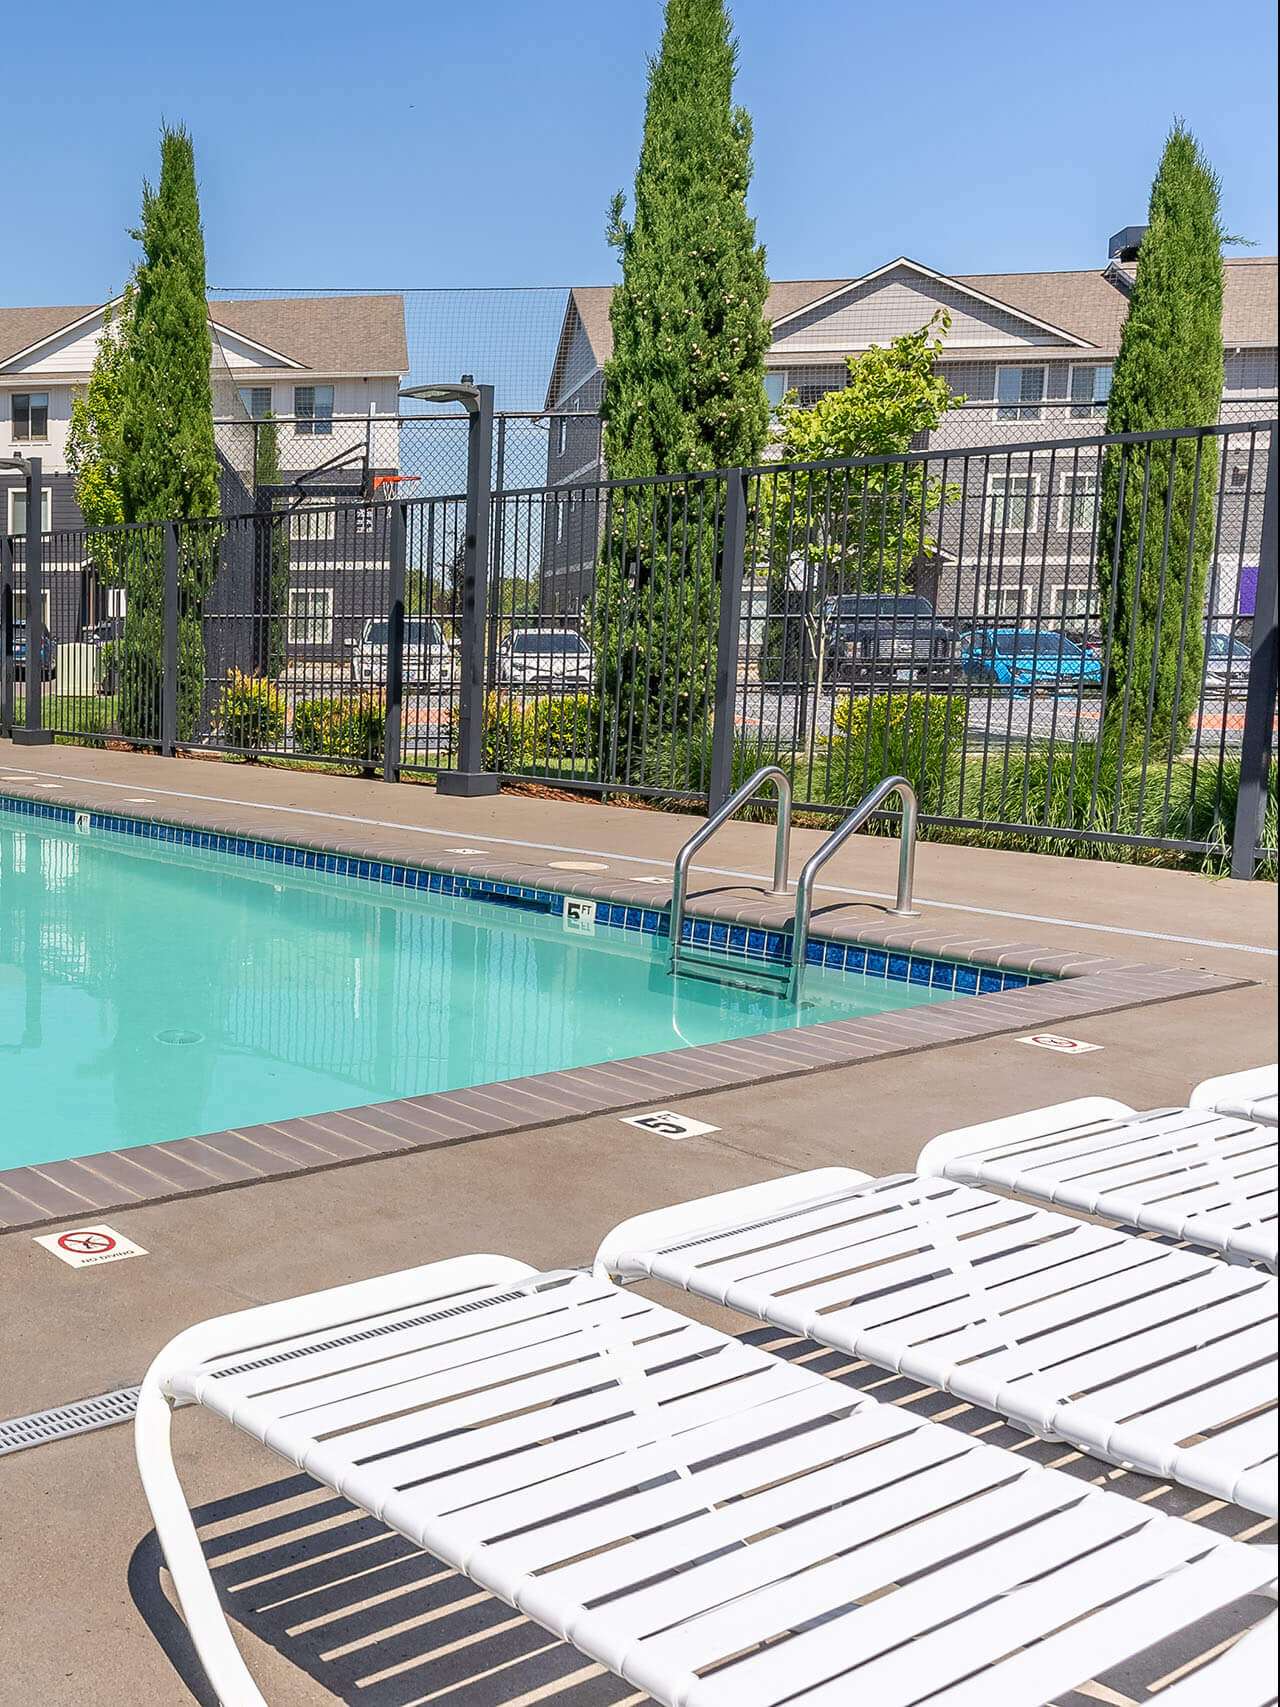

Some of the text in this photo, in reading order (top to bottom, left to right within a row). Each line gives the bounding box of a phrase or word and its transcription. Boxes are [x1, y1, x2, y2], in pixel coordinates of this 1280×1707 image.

[568, 903, 592, 919] 5 FT
[633, 1118, 687, 1134] 5
[81, 1256, 99, 1264] NO
